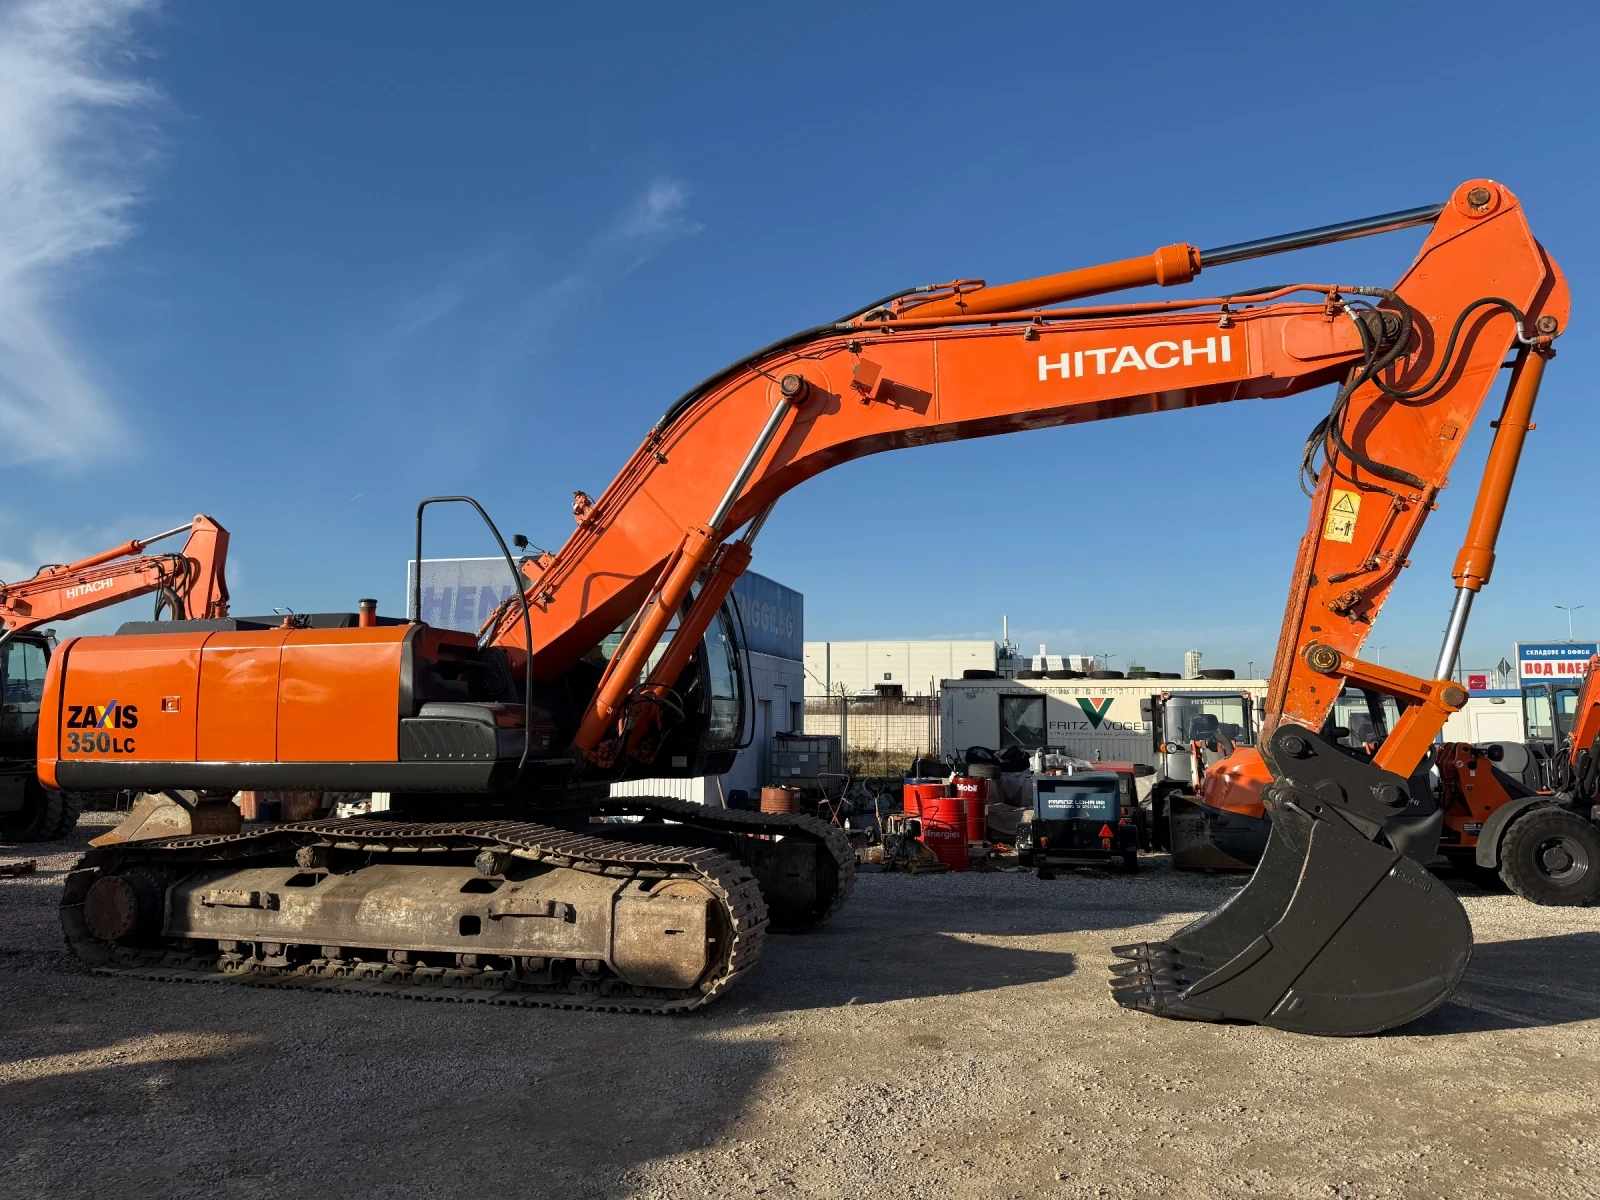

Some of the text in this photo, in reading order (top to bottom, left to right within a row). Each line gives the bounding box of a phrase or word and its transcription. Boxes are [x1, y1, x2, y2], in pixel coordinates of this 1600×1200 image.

[1038, 335, 1231, 382] HITACHI
[65, 577, 113, 599] HITACHI
[1524, 662, 1553, 676] ПОД
[66, 699, 138, 729] ZAXIS
[1049, 721, 1151, 731] FRITZ VOGEL
[956, 783, 978, 792] Mobil
